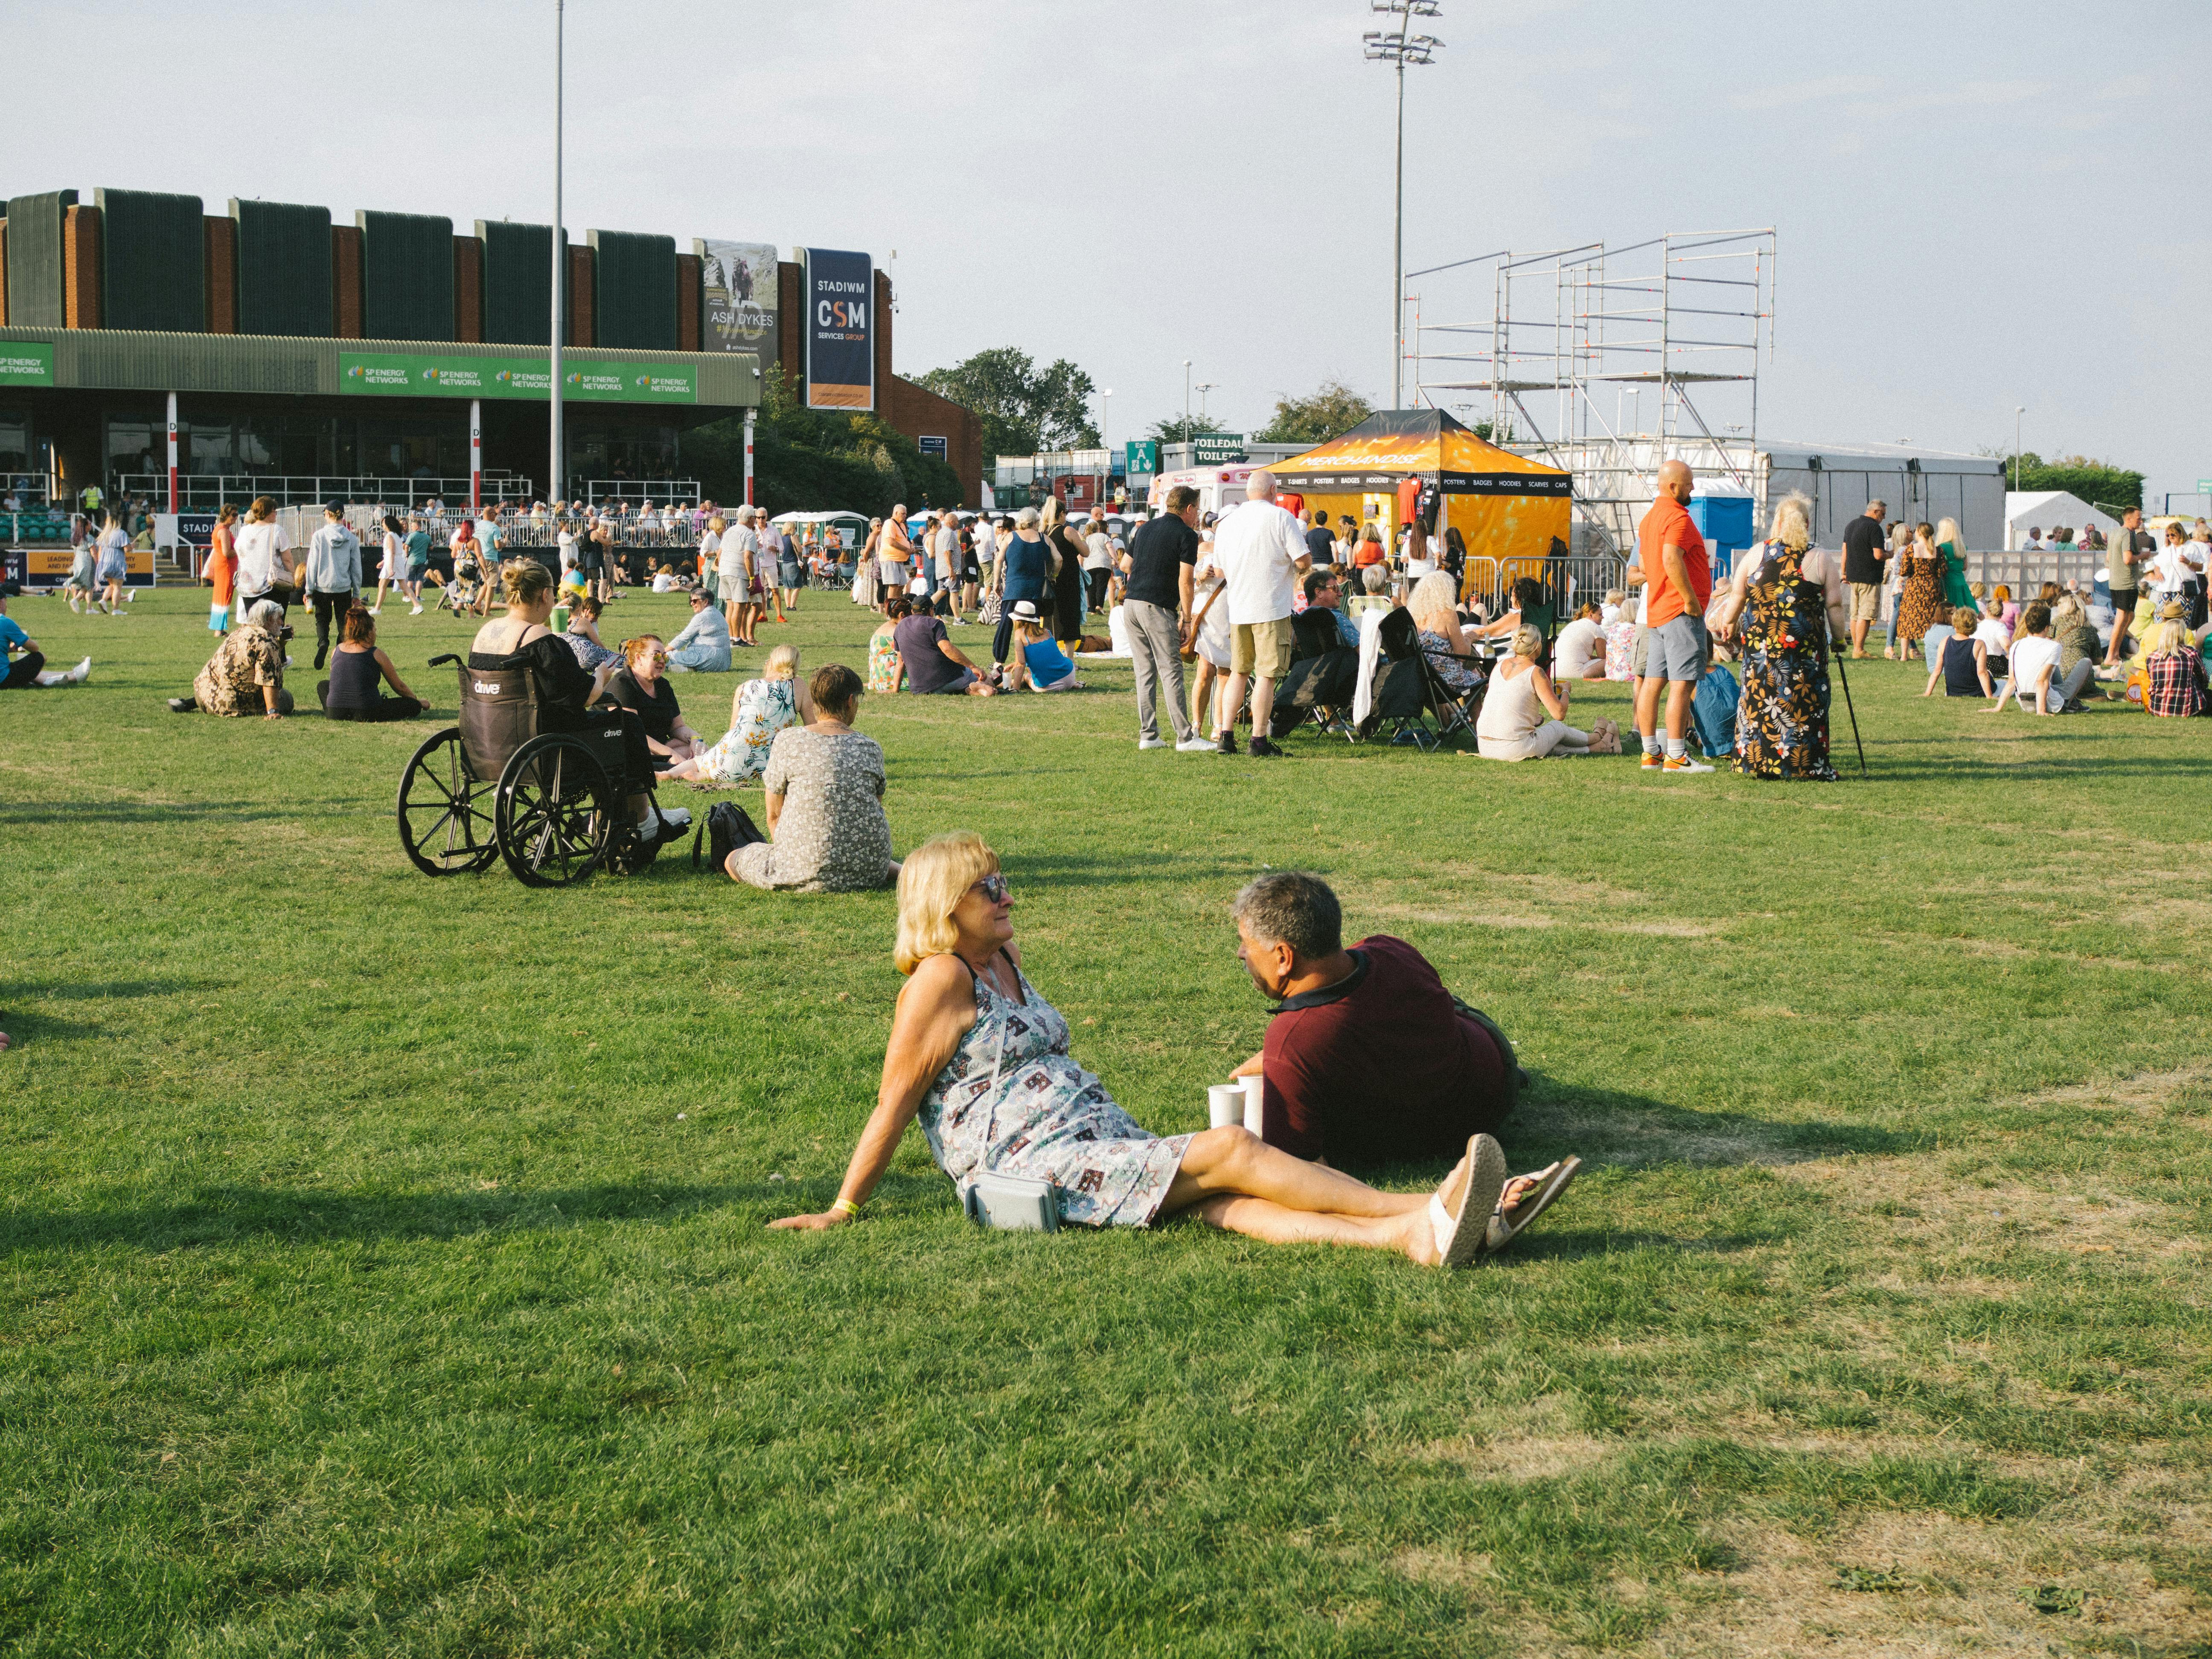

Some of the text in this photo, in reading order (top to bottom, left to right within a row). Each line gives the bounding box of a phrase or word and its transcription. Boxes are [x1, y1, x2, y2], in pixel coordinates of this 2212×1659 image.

[818, 281, 864, 293] STADIWM
[711, 311, 773, 326] ASH DYKES
[818, 300, 865, 329] CSM
[1194, 439, 1243, 448] TOILEDAU
[1137, 448, 1146, 459] A
[1299, 454, 1425, 466] MERCHANDISE
[183, 524, 212, 533] STADI
[474, 680, 500, 694] drive
[604, 729, 622, 737] drive
